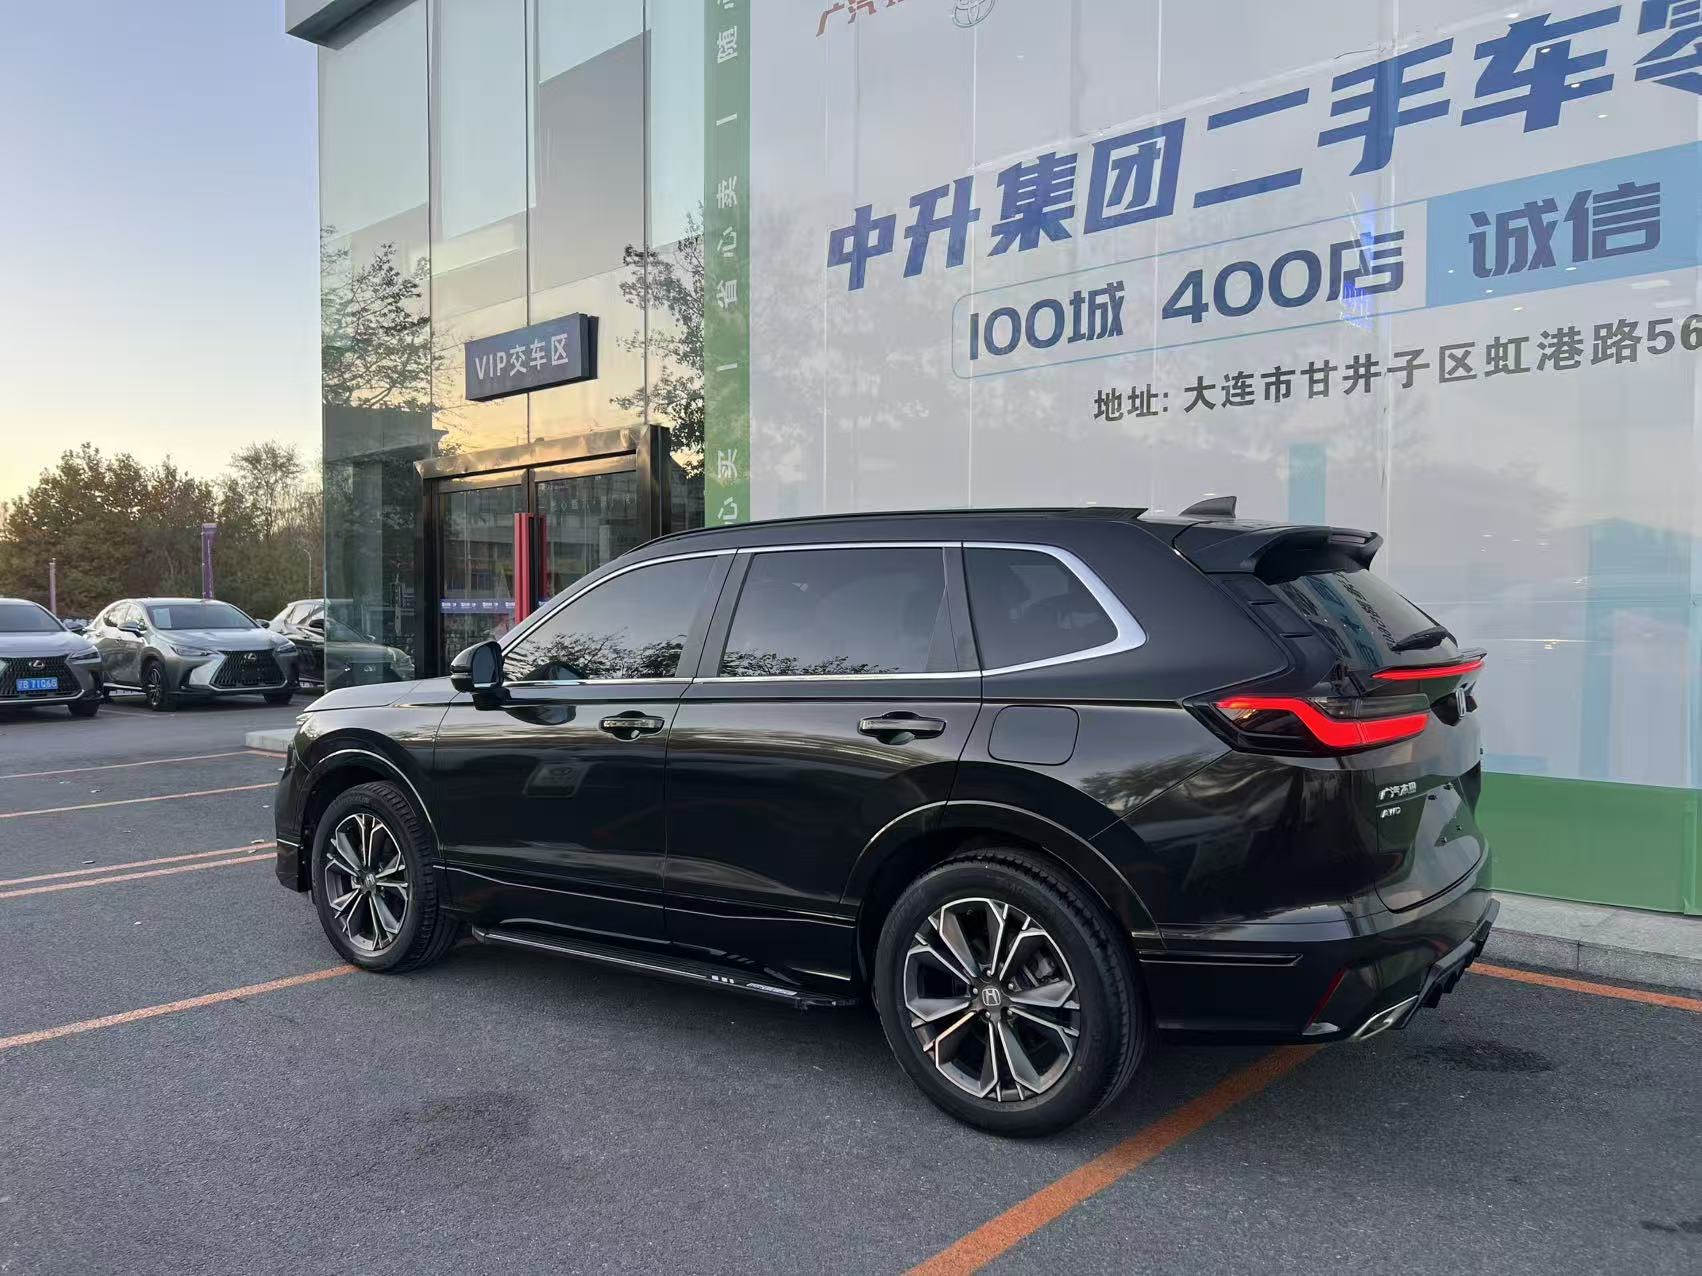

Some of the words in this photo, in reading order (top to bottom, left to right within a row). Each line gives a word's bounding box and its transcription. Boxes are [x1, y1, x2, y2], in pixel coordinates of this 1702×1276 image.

[717, 0, 738, 63] 随
[1468, 181, 1661, 279] 诚信
[969, 280, 1125, 360] 100城
[1161, 230, 1405, 323] 400店
[475, 333, 568, 380] VIP交车区
